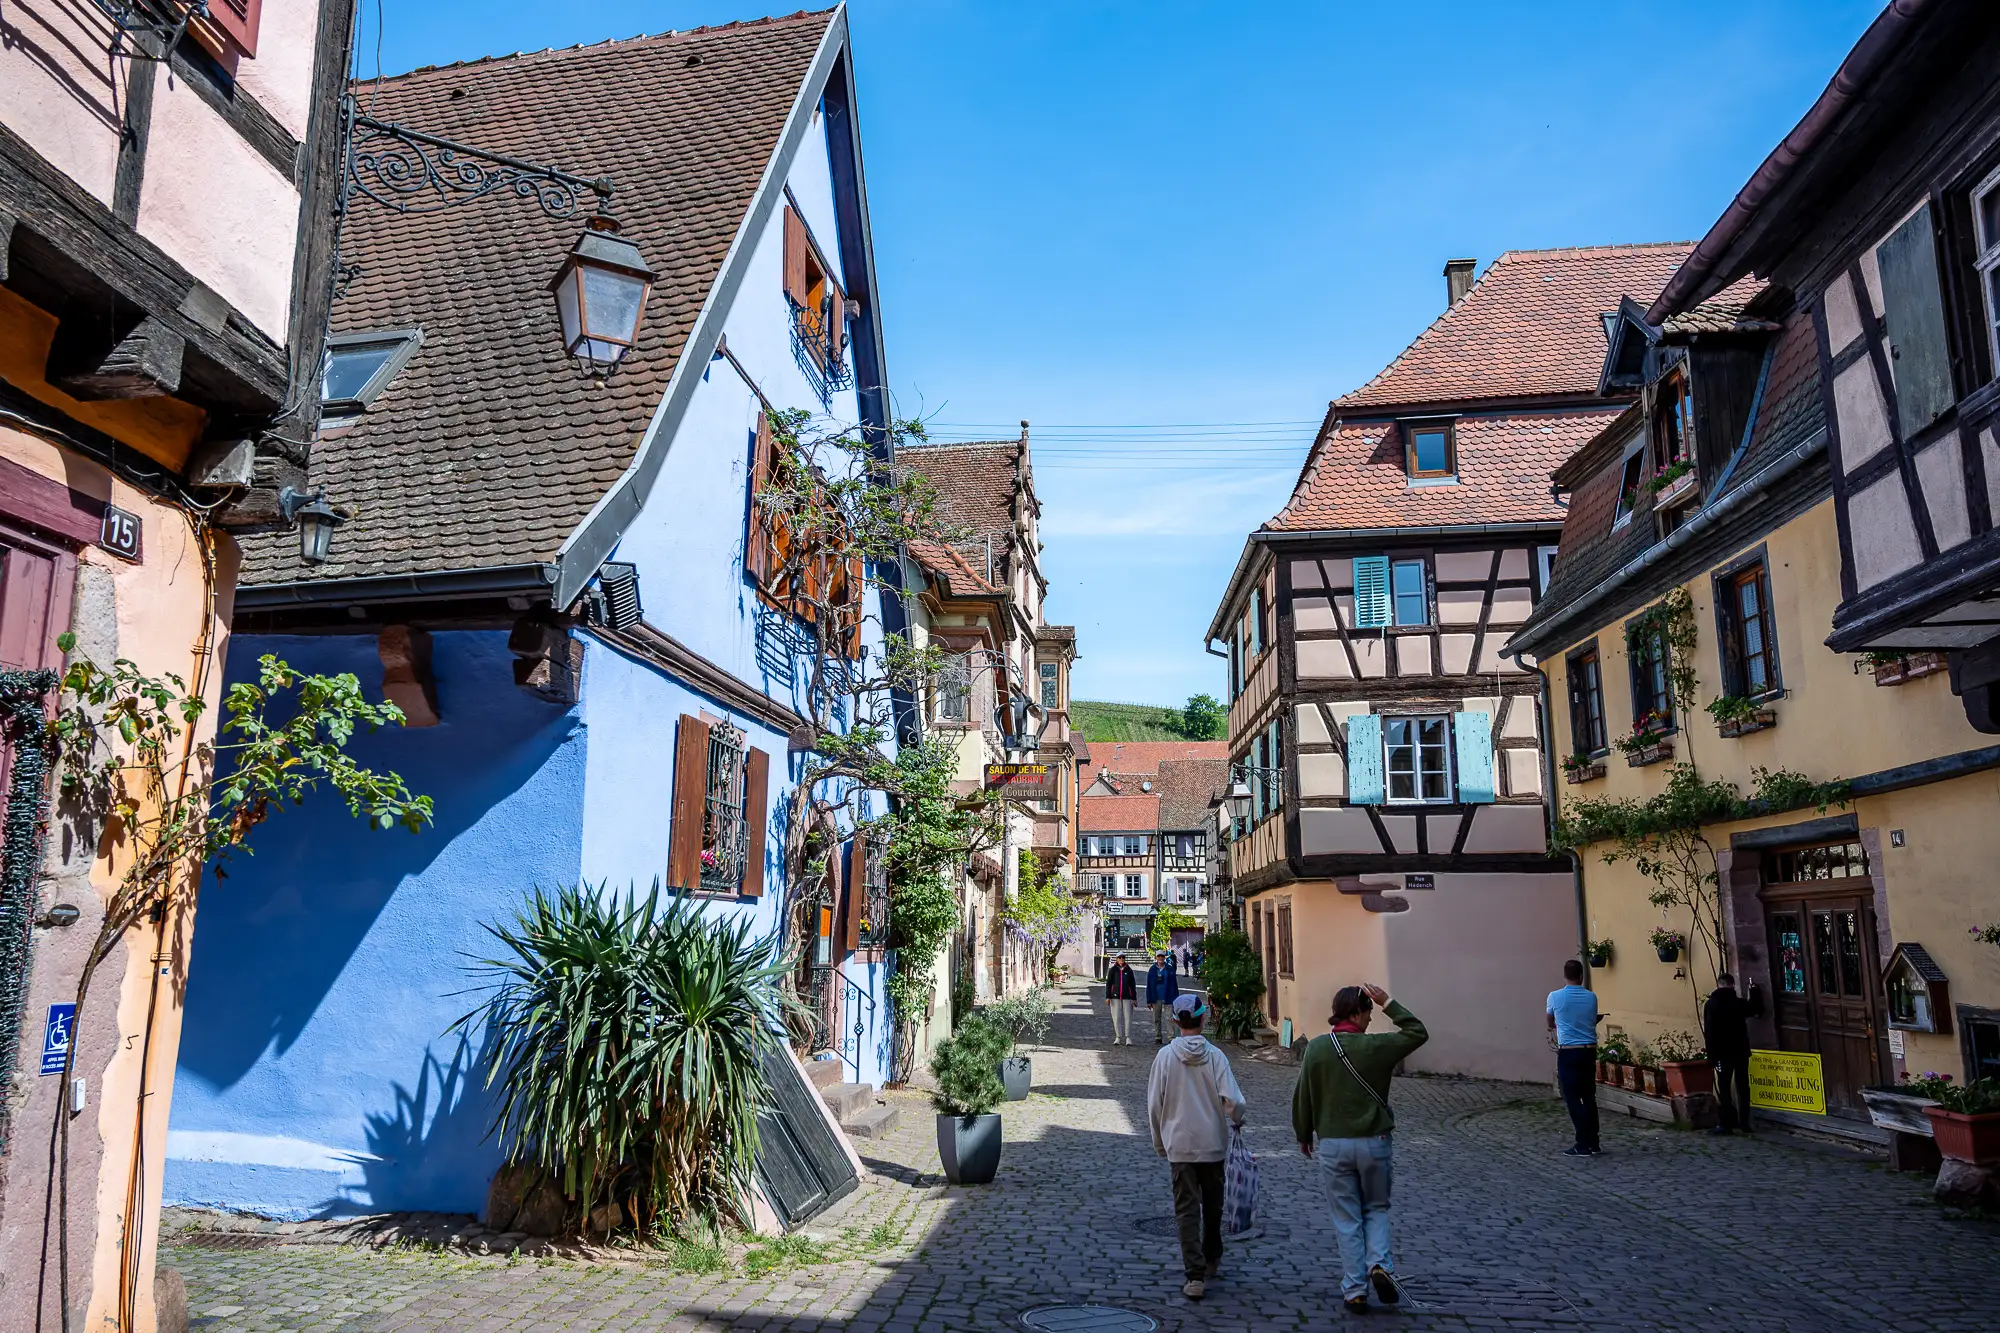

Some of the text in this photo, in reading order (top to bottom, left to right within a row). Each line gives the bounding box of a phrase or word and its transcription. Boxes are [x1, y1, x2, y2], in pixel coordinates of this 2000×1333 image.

[111, 514, 134, 548] 15
[989, 765, 1048, 775] SALON DE THE
[991, 775, 1044, 784] RESTAURANT
[1006, 786, 1049, 797] Couronne
[1892, 832, 1901, 845] 14
[1750, 1074, 1820, 1092] Domaine Daniel JUNG
[1758, 1090, 1814, 1105] 68340 RIQUEWIHR
